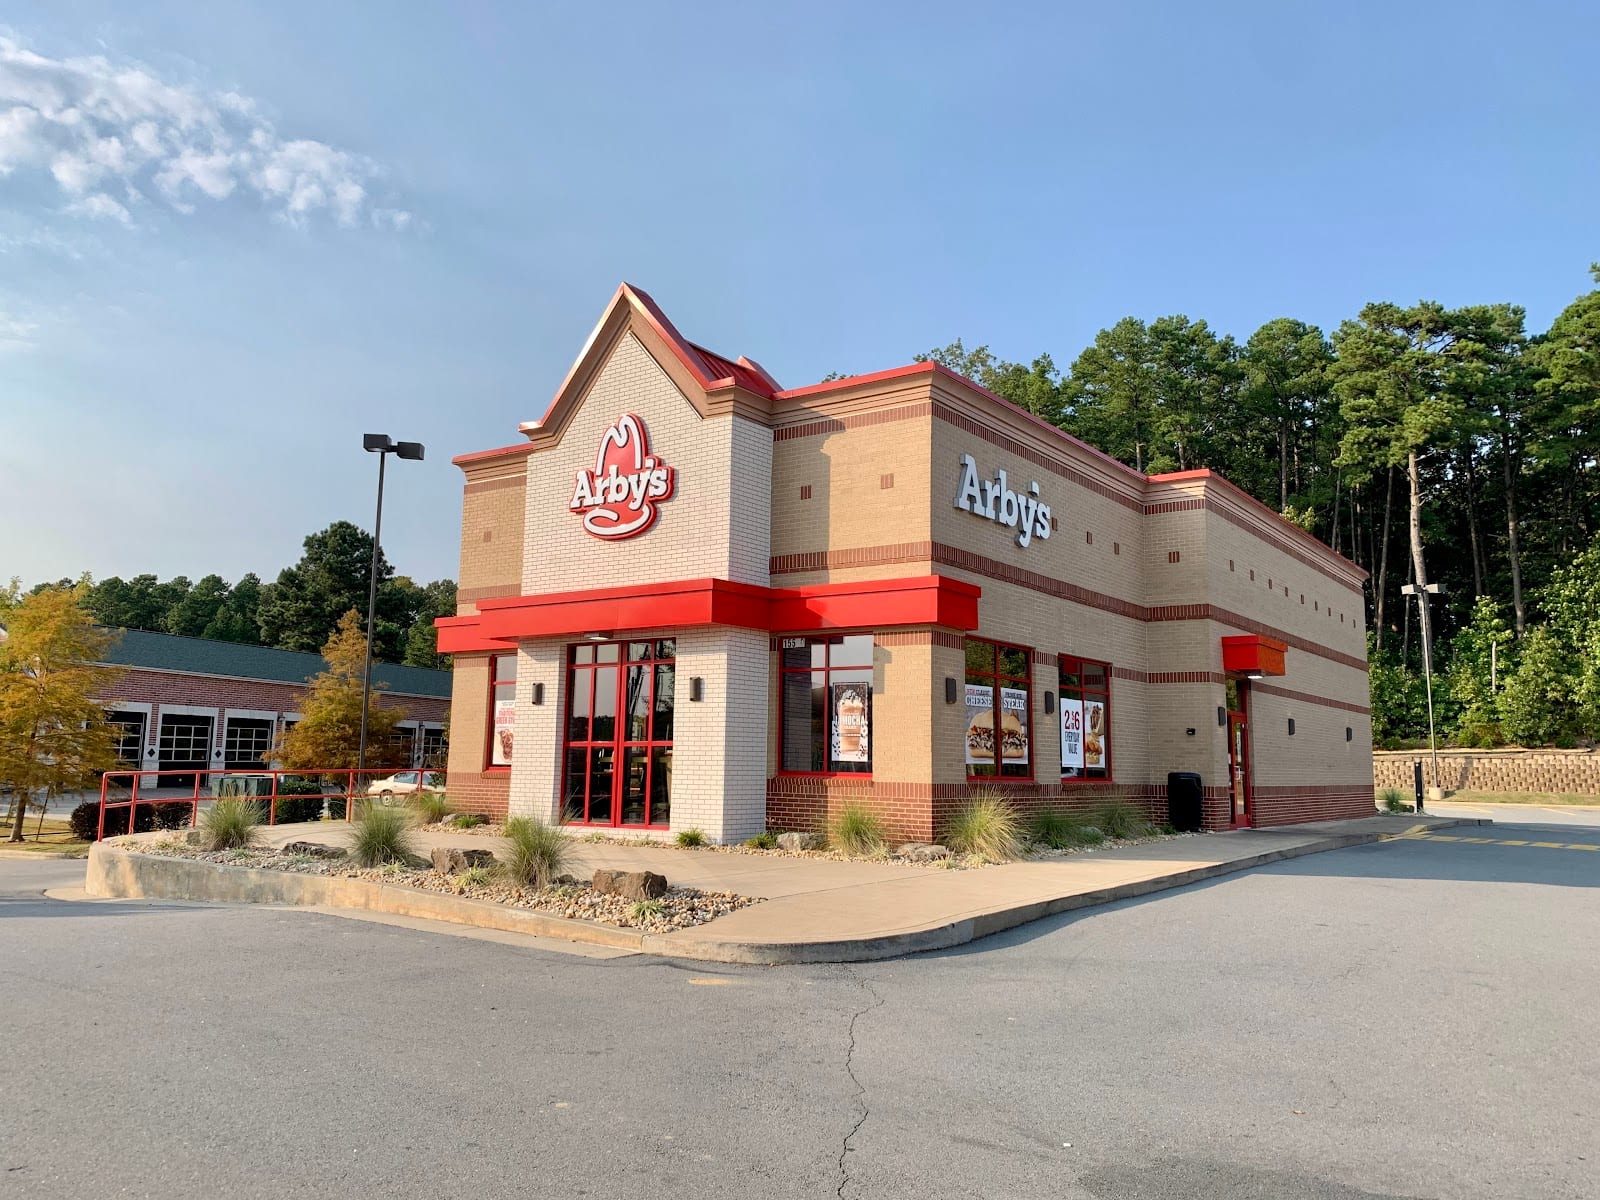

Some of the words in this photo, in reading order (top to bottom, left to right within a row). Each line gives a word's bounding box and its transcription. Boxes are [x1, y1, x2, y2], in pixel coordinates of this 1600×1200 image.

[570, 458, 668, 511] Arby's
[953, 453, 1051, 548] Arby's
[784, 640, 796, 648] 155
[965, 695, 992, 707] CHEESE
[1003, 697, 1025, 710] STEAK
[1065, 710, 1070, 729] 2
